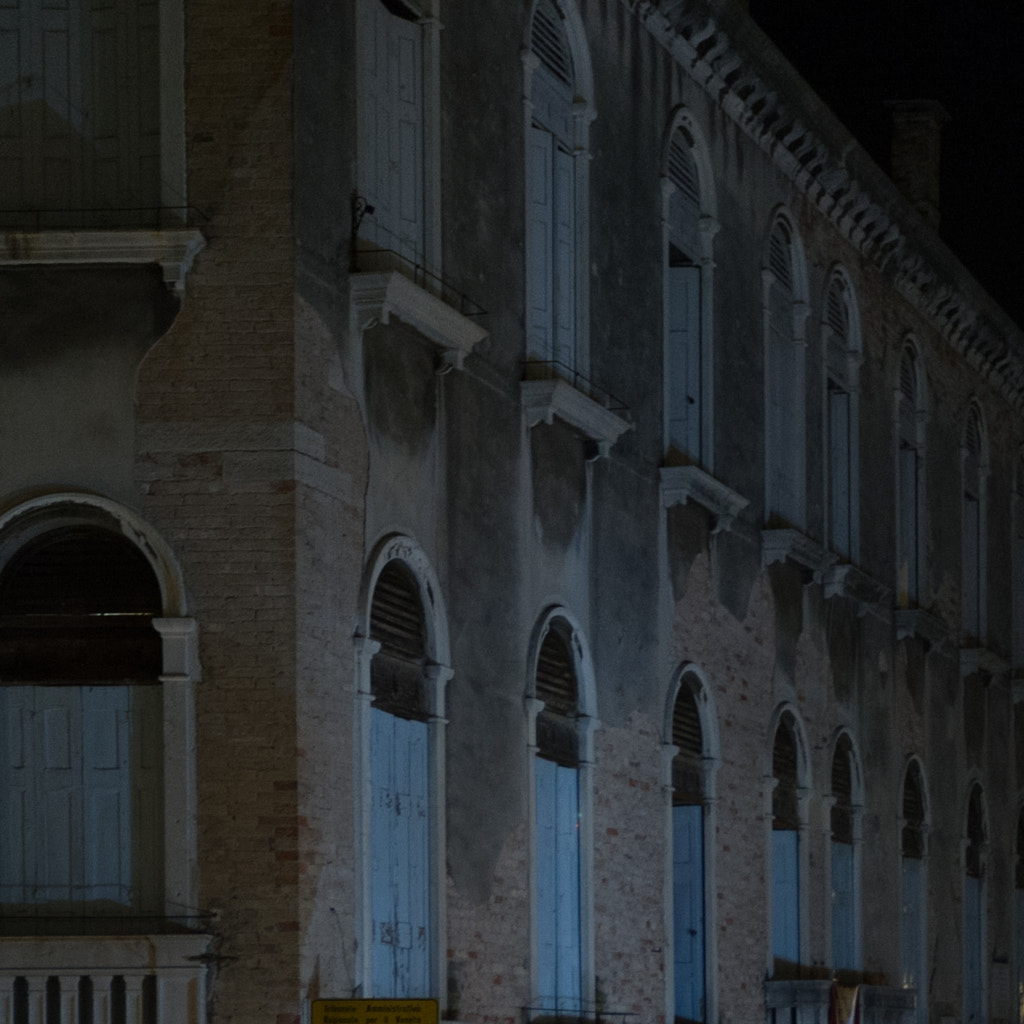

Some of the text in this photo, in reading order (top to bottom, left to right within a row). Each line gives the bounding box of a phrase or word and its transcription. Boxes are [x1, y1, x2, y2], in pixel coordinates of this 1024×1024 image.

[323, 1015, 358, 1024] Regionale
[365, 1017, 377, 1024] per
[396, 1015, 421, 1024] Veneto
